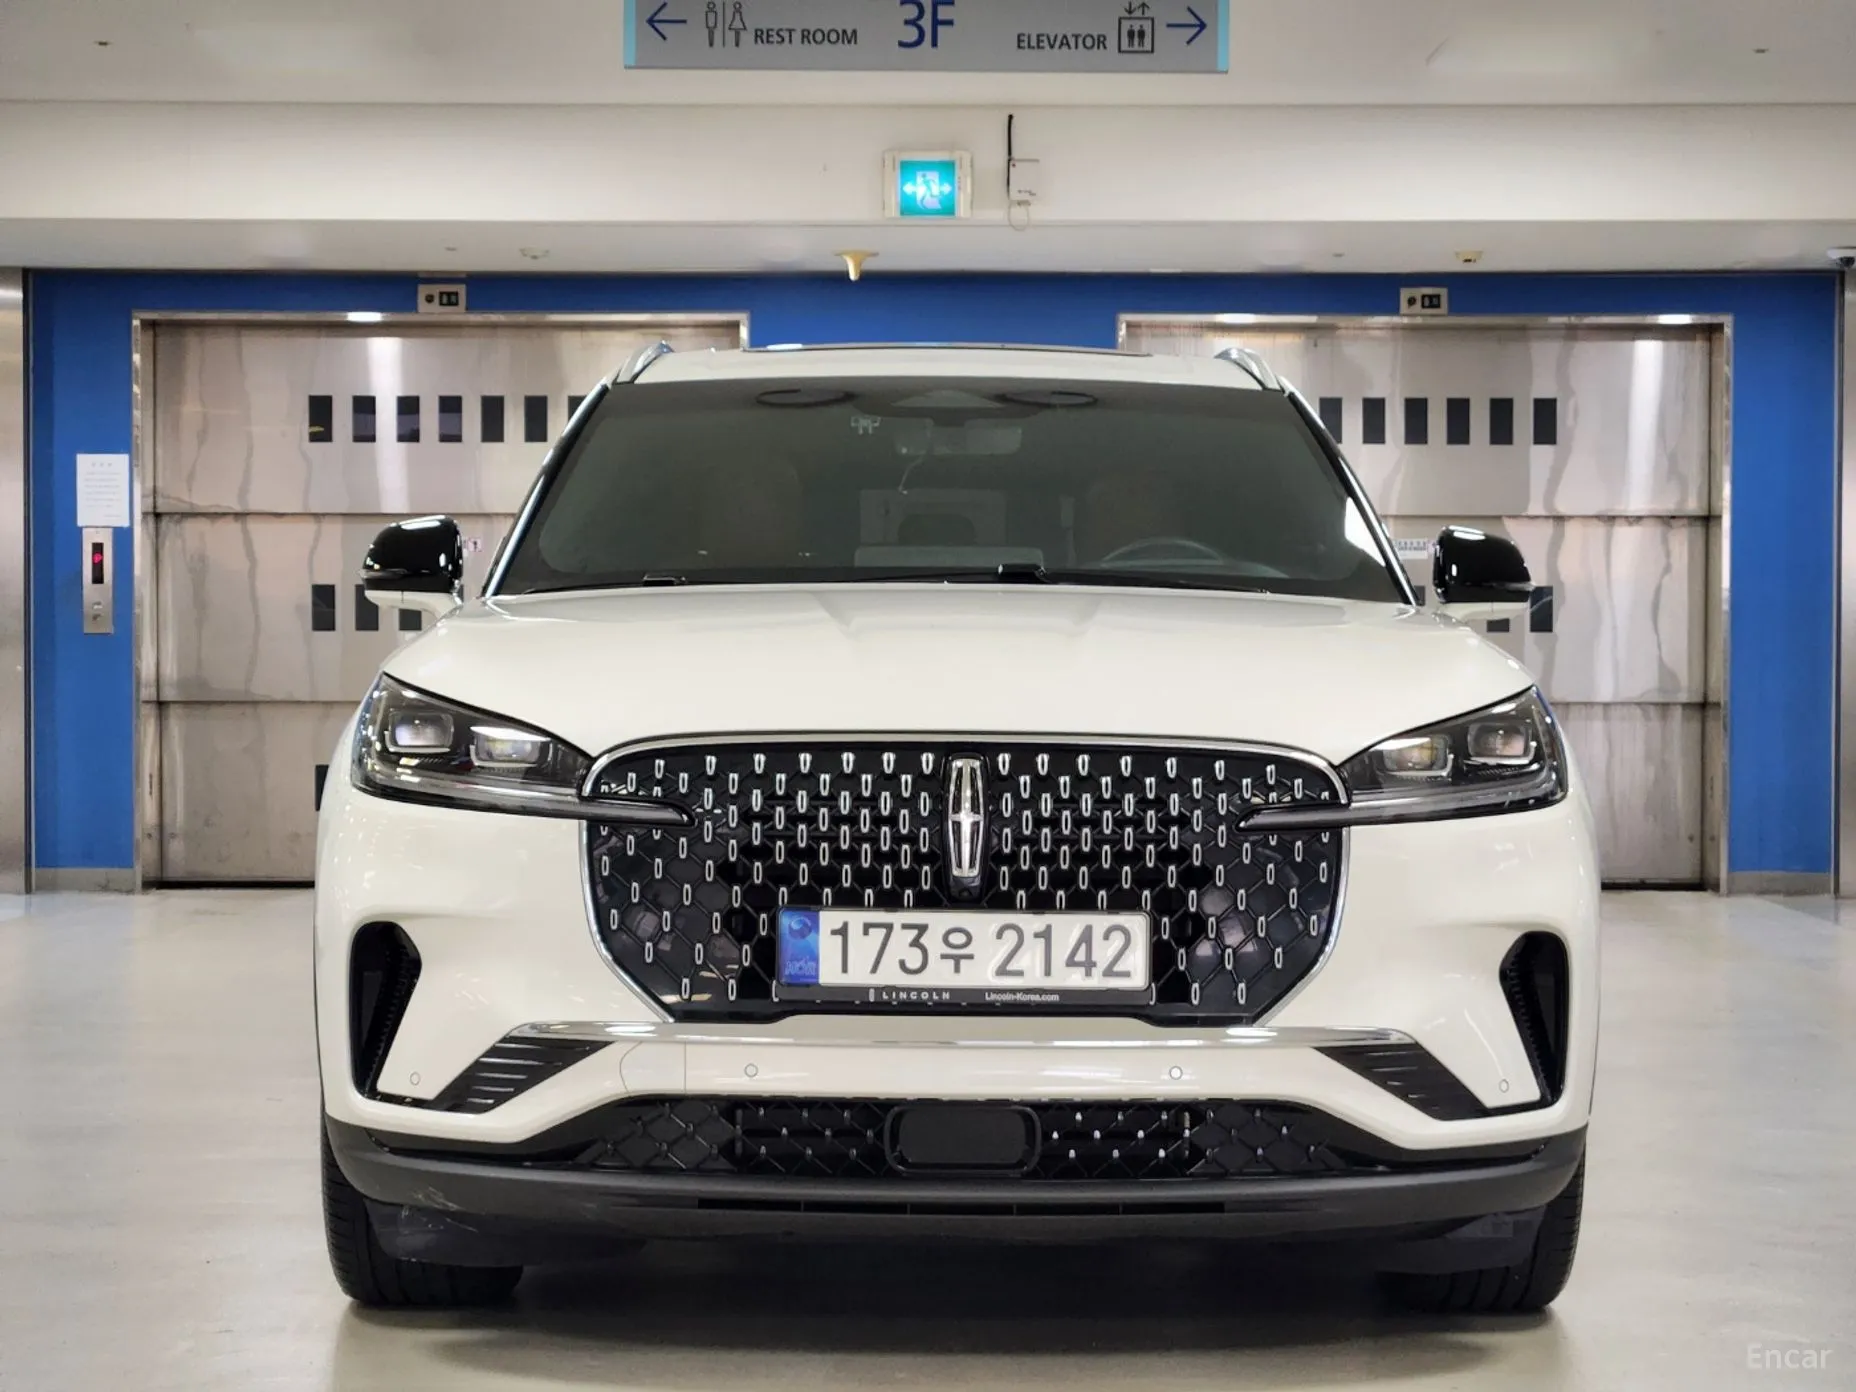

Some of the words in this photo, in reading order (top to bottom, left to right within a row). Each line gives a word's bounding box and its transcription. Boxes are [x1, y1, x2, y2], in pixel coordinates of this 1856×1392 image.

[898, 0, 955, 48] 3F
[754, 28, 796, 45] REST
[801, 28, 858, 45] ROOM
[1016, 33, 1108, 50] ELEVATOR
[830, 921, 974, 975] 173우
[994, 923, 1132, 978] 2142
[882, 991, 951, 1000] LINCOLN
[985, 991, 1060, 1002] Lincoln-Korea.com
